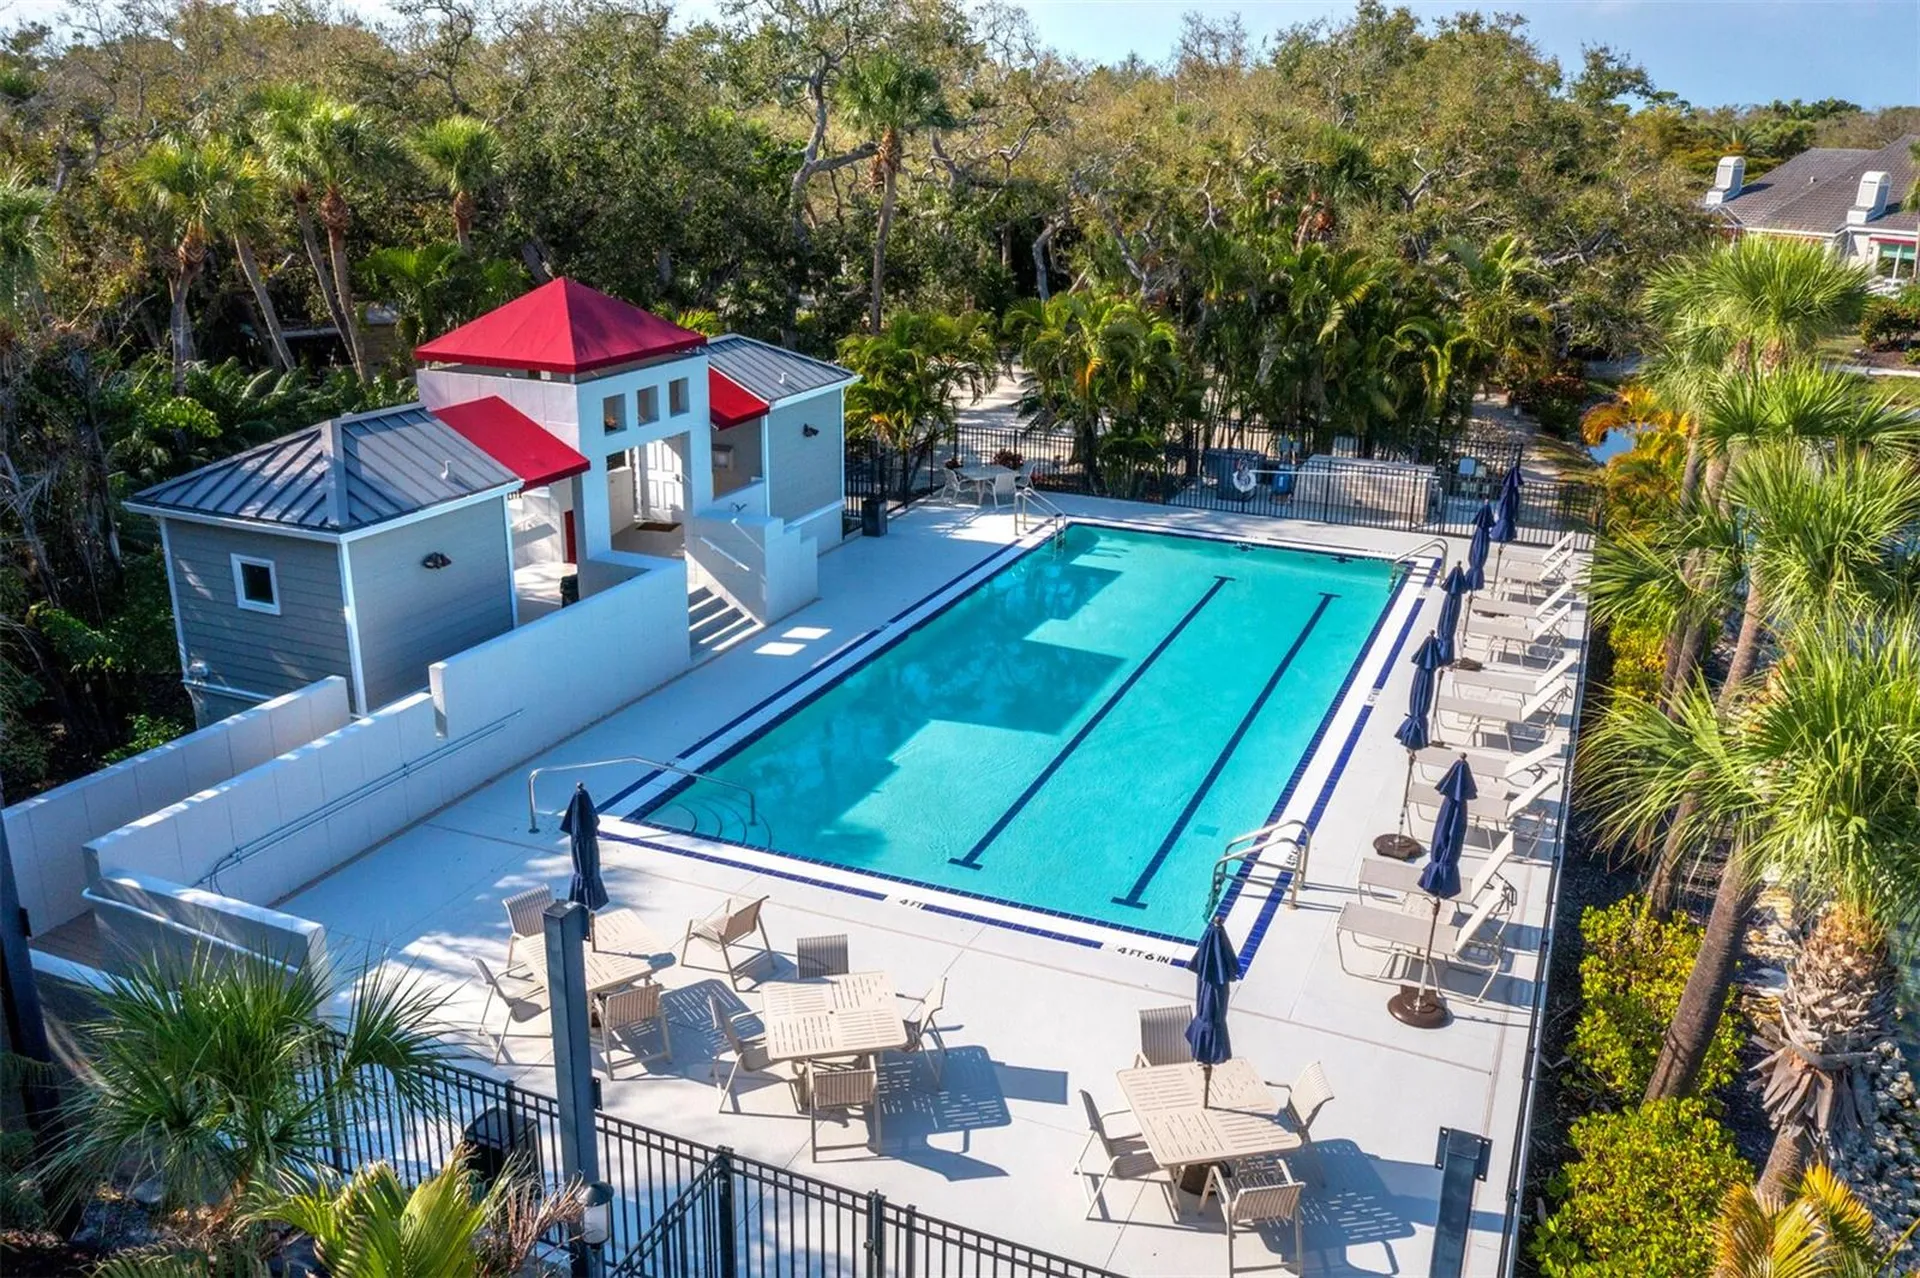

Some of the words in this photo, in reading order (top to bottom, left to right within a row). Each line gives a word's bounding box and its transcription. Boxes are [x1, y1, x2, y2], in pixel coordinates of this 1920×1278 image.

[1117, 947, 1127, 955] 4
[1129, 948, 1145, 958] FT
[1144, 953, 1155, 961] 6
[1156, 955, 1170, 964] IN
